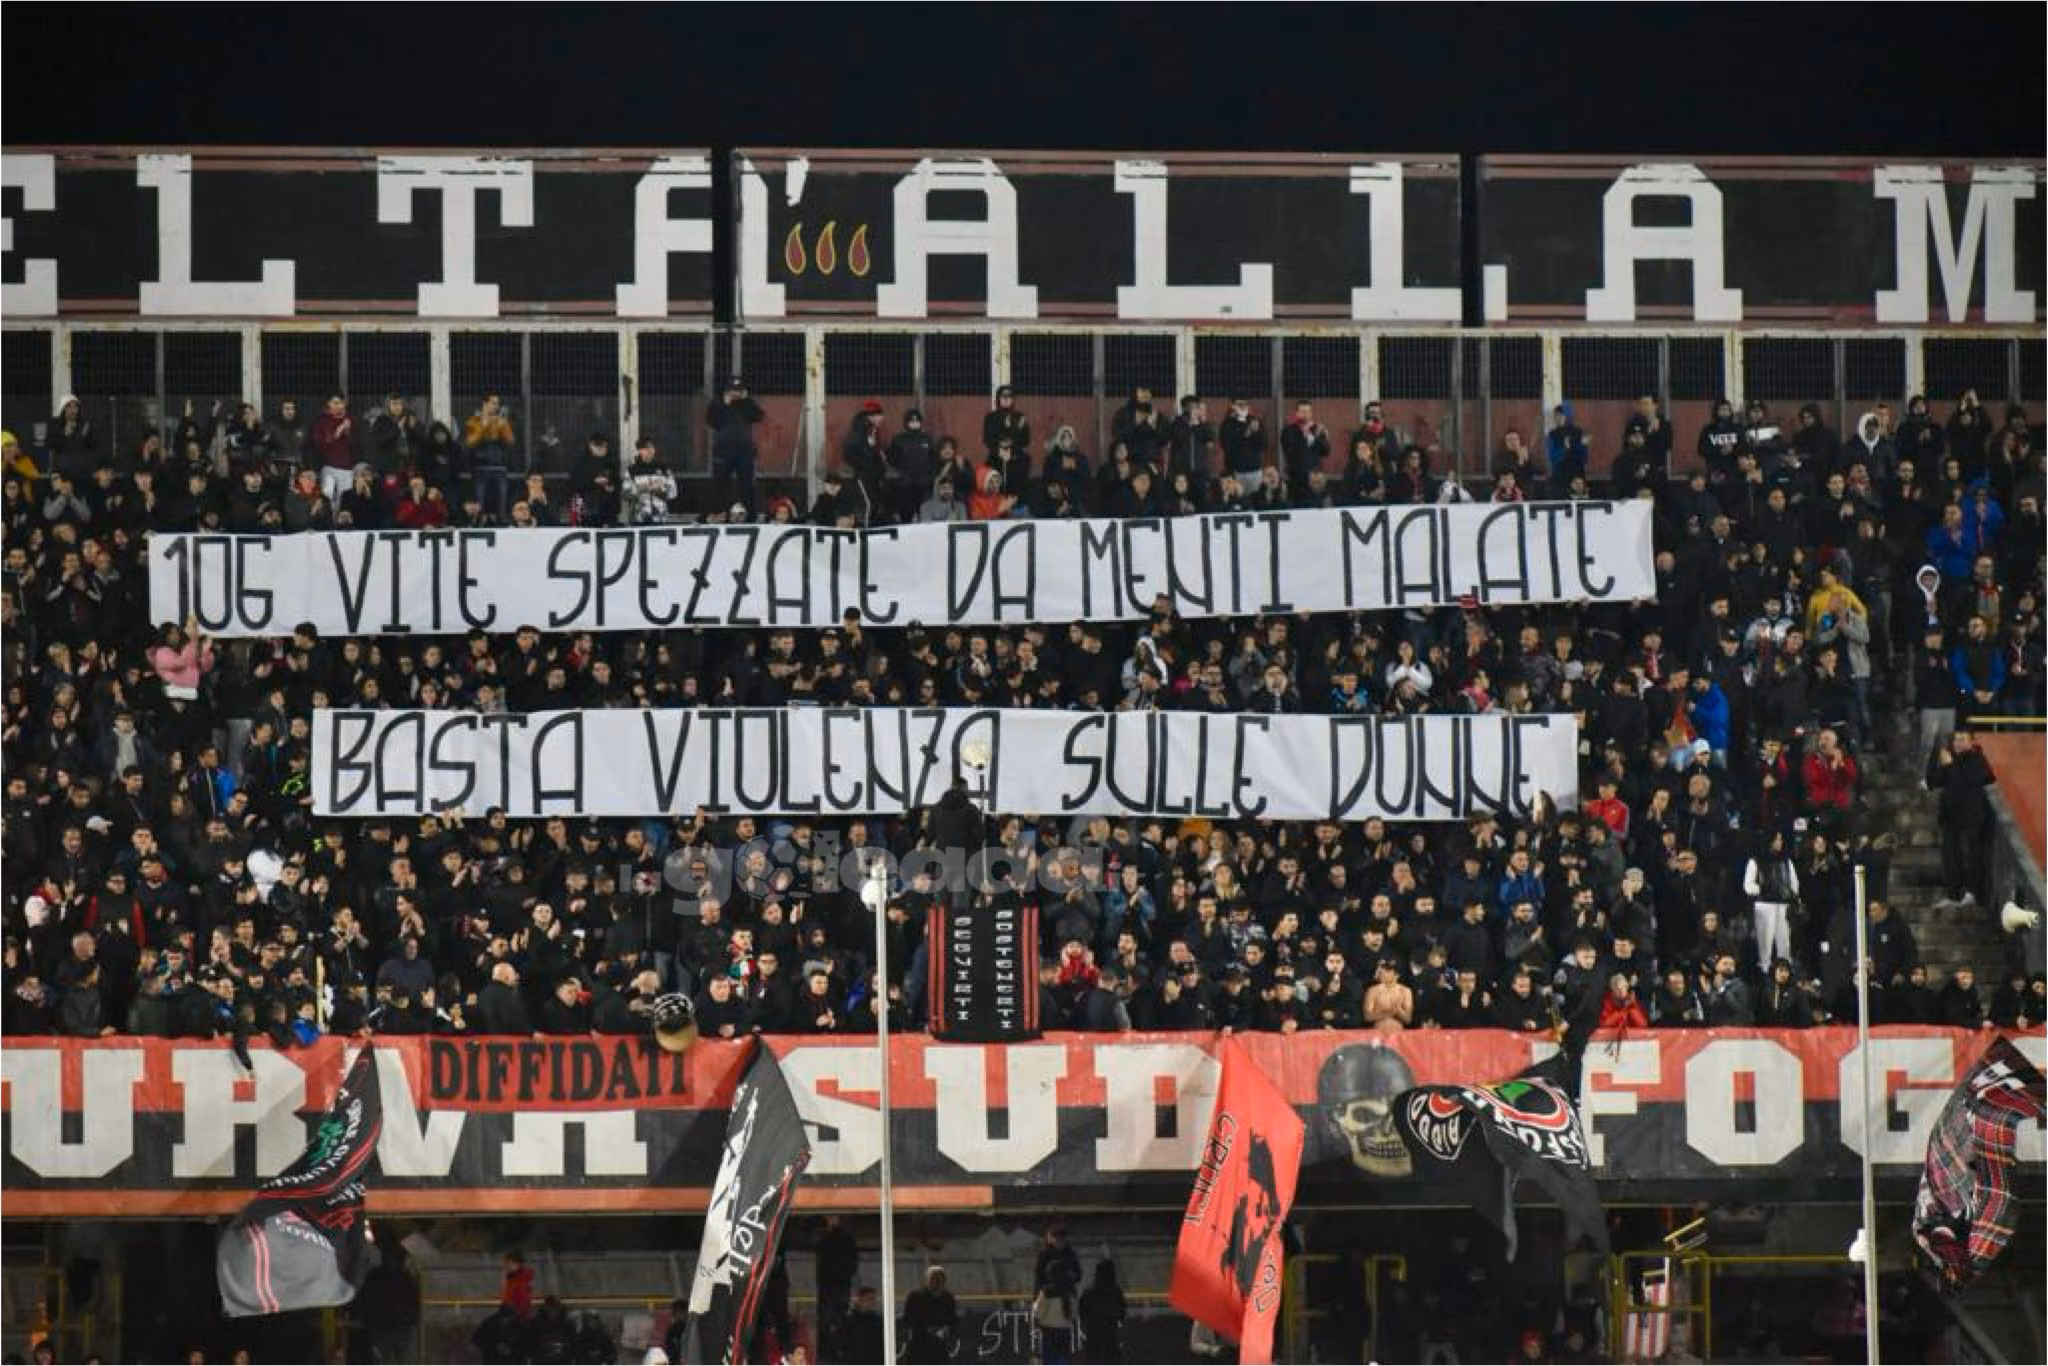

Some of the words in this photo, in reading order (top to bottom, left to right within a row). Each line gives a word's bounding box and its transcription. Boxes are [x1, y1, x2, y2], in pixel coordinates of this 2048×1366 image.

[164, 536, 273, 630] 106
[327, 531, 496, 633] VITE
[547, 527, 898, 628] SPEZZATE
[948, 523, 1035, 621] DA
[1080, 513, 1294, 617] MENTI
[1340, 503, 1615, 607] MALATE
[329, 711, 583, 814] BASTA
[642, 709, 999, 813] VIOLENZA
[1063, 714, 1269, 817] SULLE
[1330, 716, 1550, 818] DONNE
[429, 1039, 687, 1102] DIFFIDATI
[780, 1046, 1222, 1175] SUD
